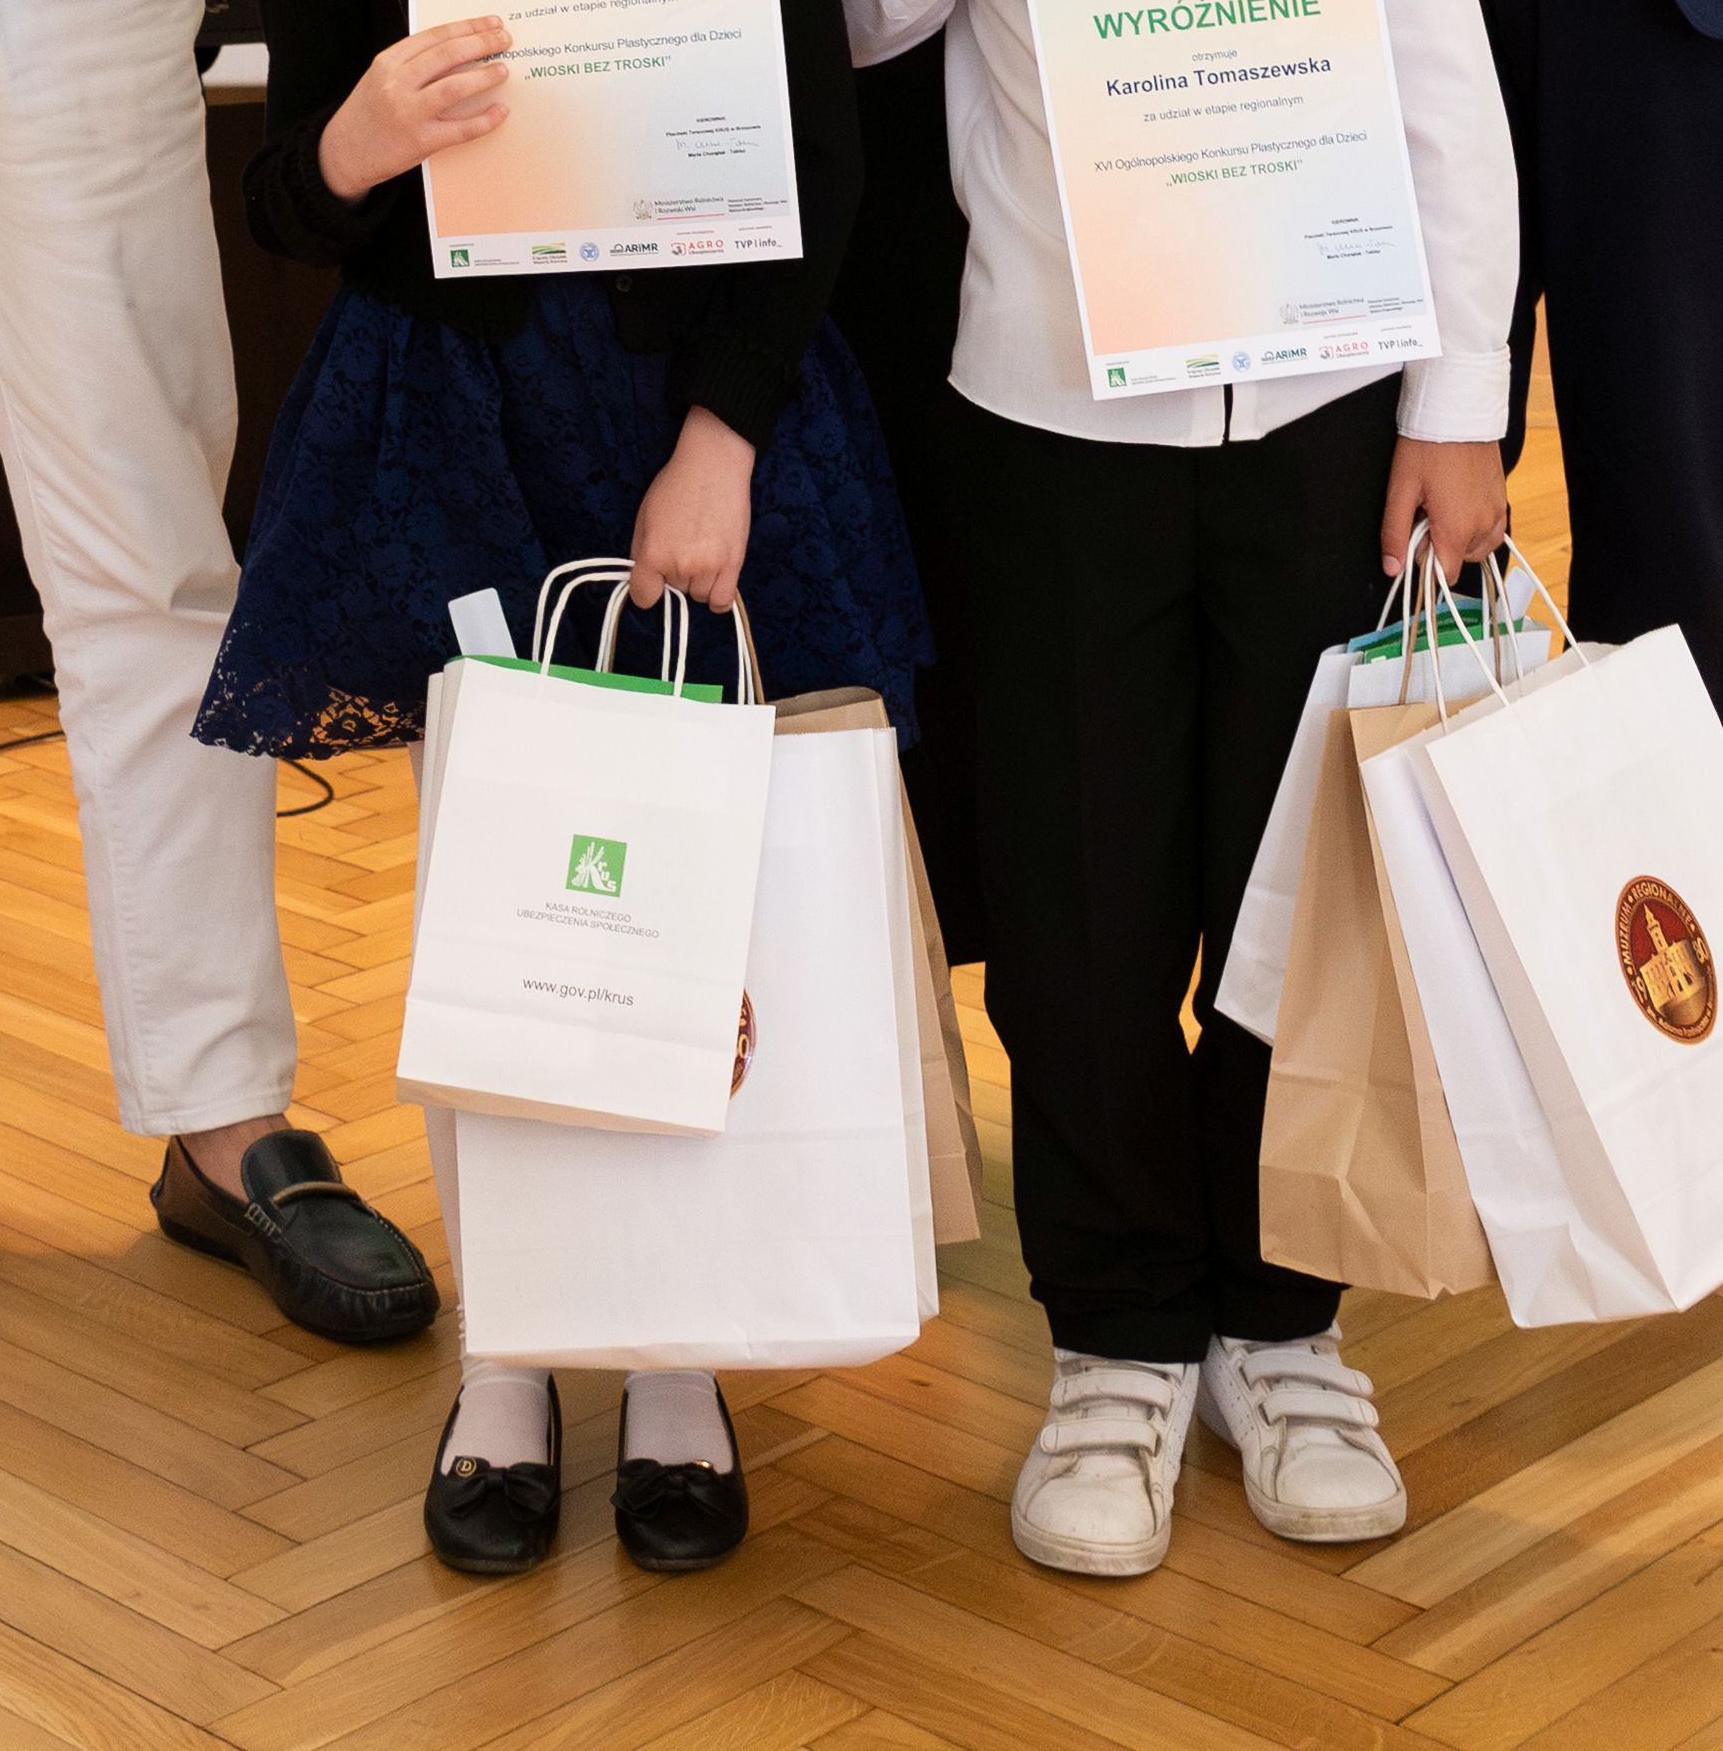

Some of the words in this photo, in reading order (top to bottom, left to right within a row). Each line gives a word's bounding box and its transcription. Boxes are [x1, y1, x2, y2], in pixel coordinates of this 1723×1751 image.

[508, 10, 523, 21] za
[525, 5, 558, 19] udział
[560, 5, 570, 14] w
[572, 0, 608, 13] etapie
[564, 39, 615, 55] Konkursu
[616, 34, 689, 52] Plastycznego
[690, 31, 707, 43] dla
[709, 27, 743, 42] Dzieci
[1191, 49, 1239, 63] otrzymuje
[584, 60, 612, 74] BEZ
[1106, 72, 1190, 97] Karolina
[1193, 56, 1333, 87] Tomaszewska
[1143, 112, 1158, 122] za
[1159, 105, 1192, 121] udział
[1193, 106, 1204, 117] w
[1204, 100, 1239, 116] etapie
[1239, 94, 1305, 112] regionalnym
[1094, 160, 1115, 173] XVI
[1115, 150, 1201, 172] Ogólnopolskiego
[1201, 145, 1250, 160] Konkursu
[1250, 138, 1319, 155] Plastycznego
[1319, 133, 1335, 146] dla
[1335, 130, 1368, 144] Dzieci
[1221, 164, 1249, 179] BEZ
[624, 242, 659, 253] ARiMR
[689, 239, 724, 250] AGRO
[1275, 347, 1309, 361] ARiMR
[1334, 341, 1370, 353] AGRO
[545, 901, 571, 915] KASA
[571, 905, 632, 923] ROLNICZEGO
[516, 908, 589, 928] UBEZPIECZENIA
[590, 920, 660, 939] SPOŁECZNEGO
[523, 978, 635, 1006] www.gov.pl/krus
